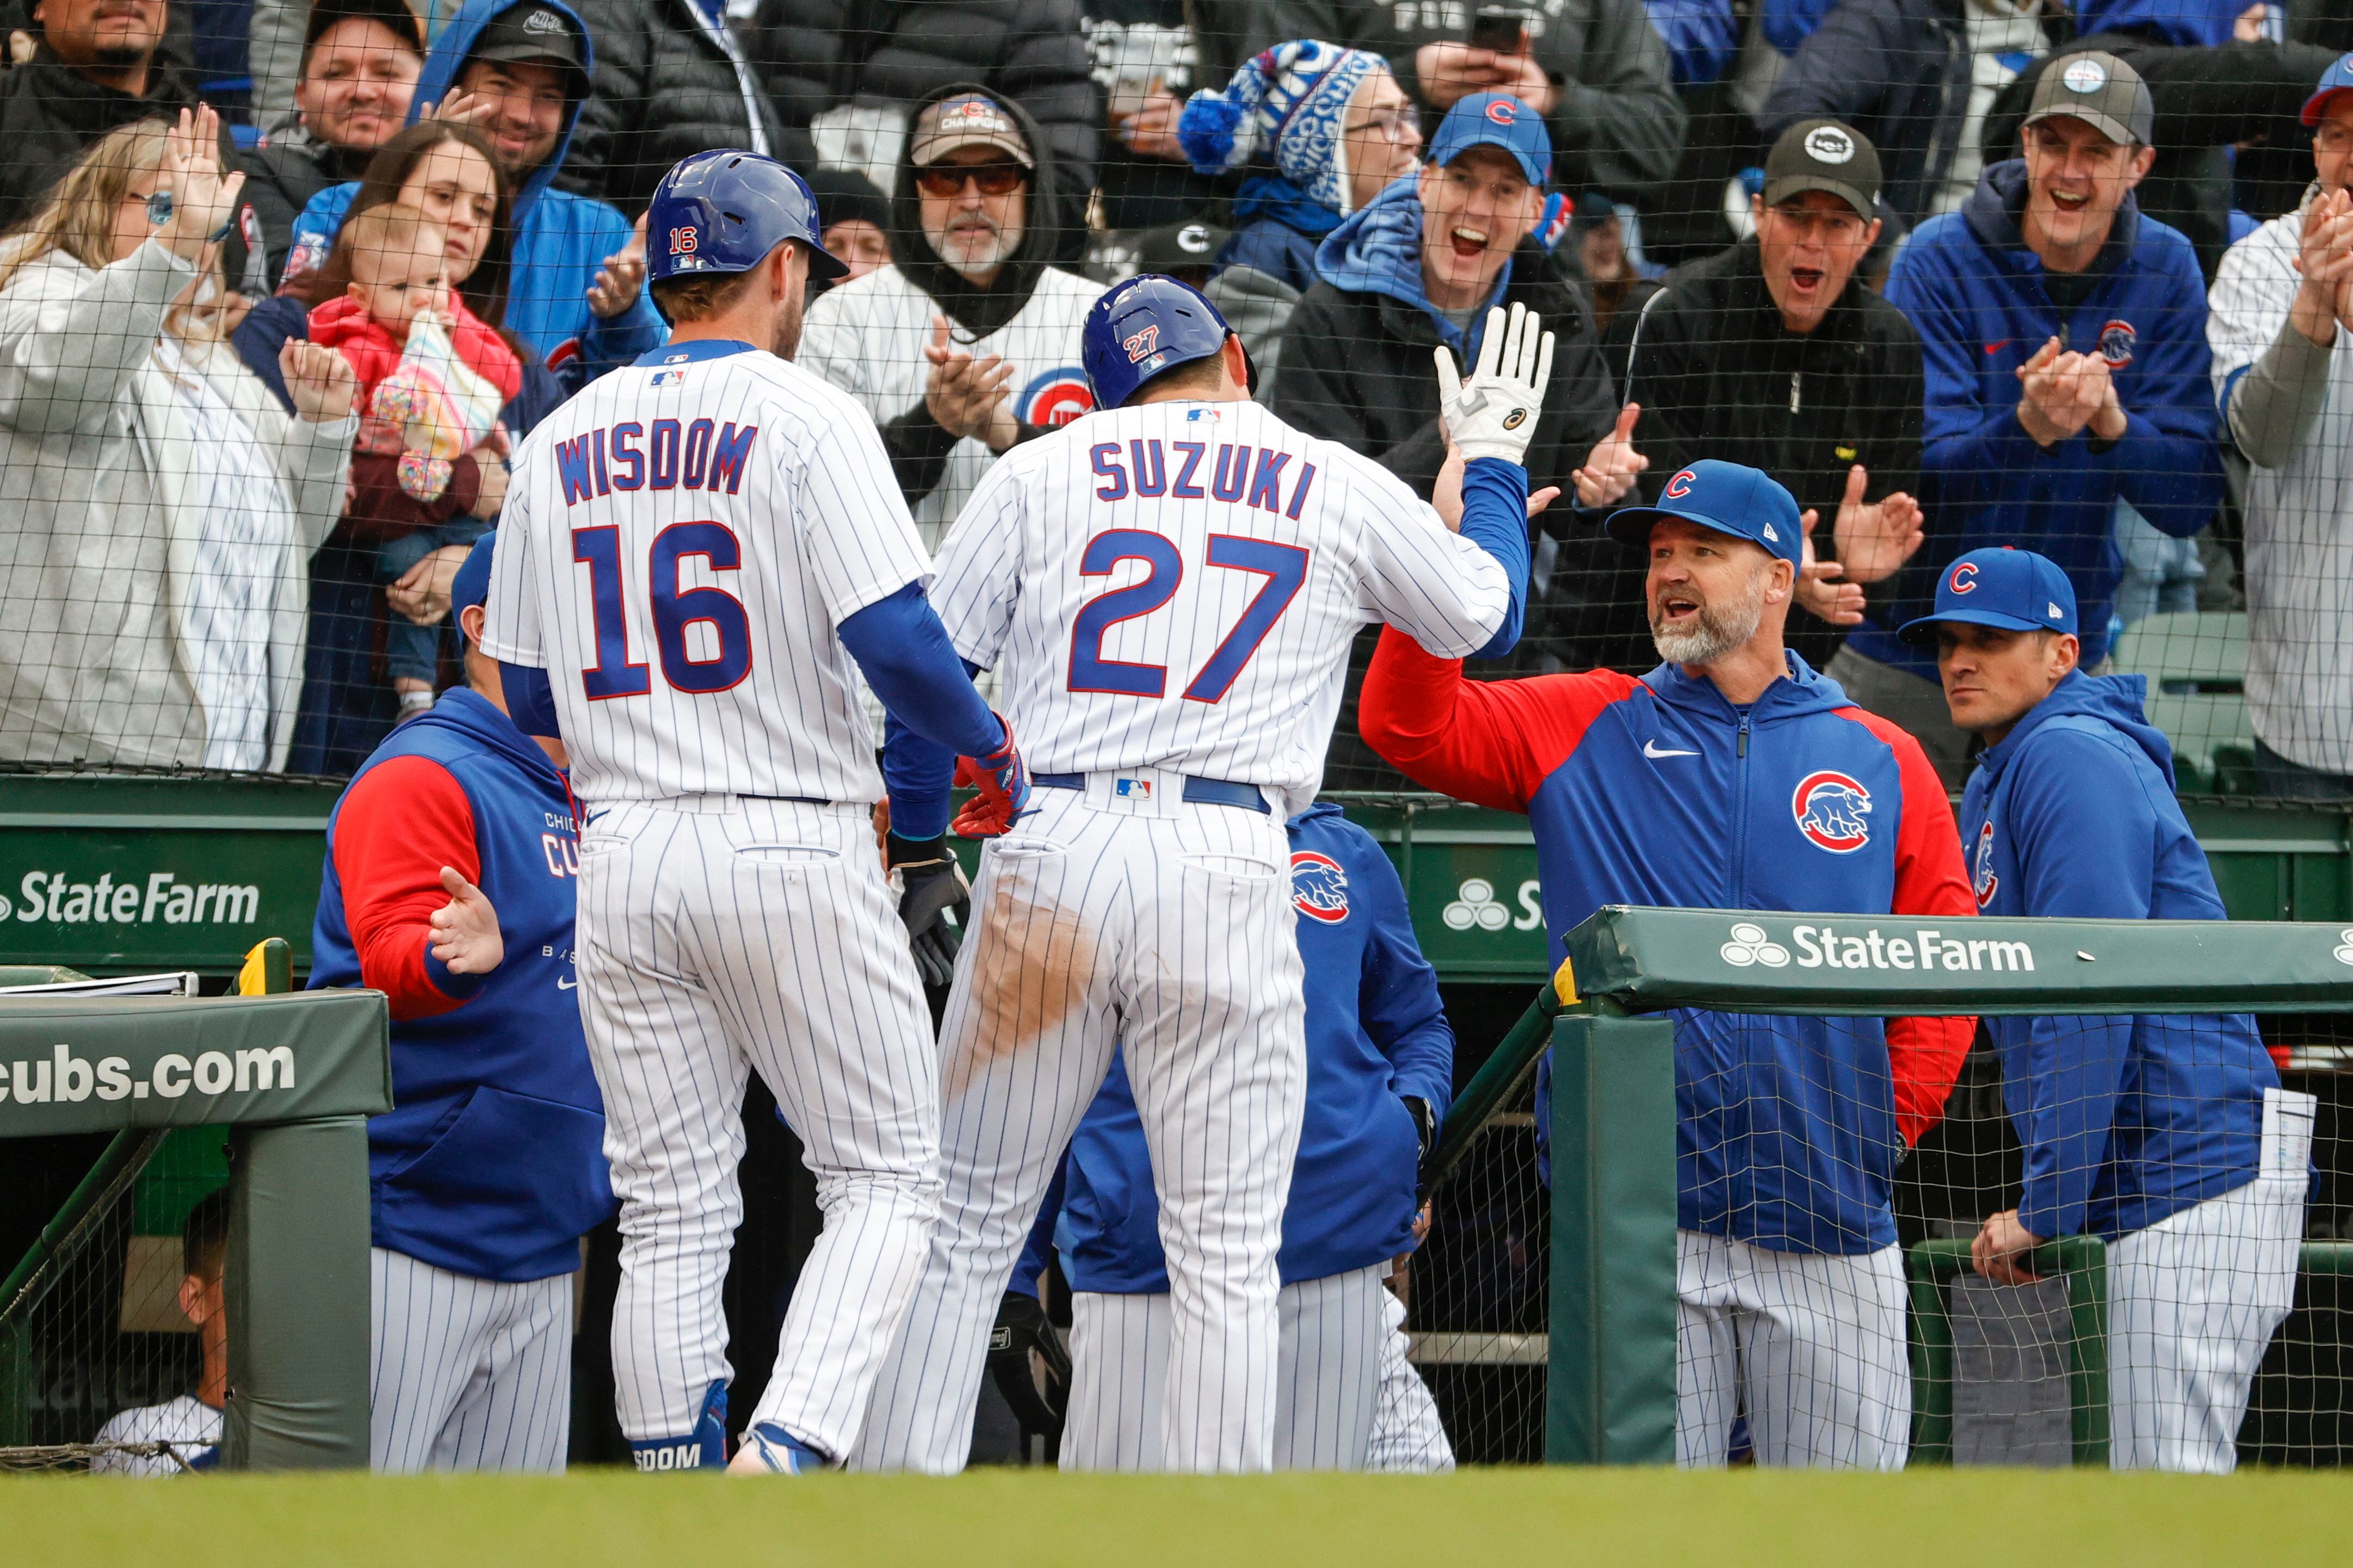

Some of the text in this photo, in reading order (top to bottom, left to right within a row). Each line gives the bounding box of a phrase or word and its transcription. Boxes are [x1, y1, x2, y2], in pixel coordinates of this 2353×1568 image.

[670, 226, 697, 255] 16
[1123, 324, 1159, 364] 27
[555, 418, 758, 506] WISDOM
[1090, 439, 1316, 520] SUZUKI
[1666, 470, 1697, 499] C
[1950, 562, 1980, 595] C
[572, 520, 752, 701] 16
[1067, 529, 1310, 705] 27
[0, 1043, 295, 1105] ubs.com
